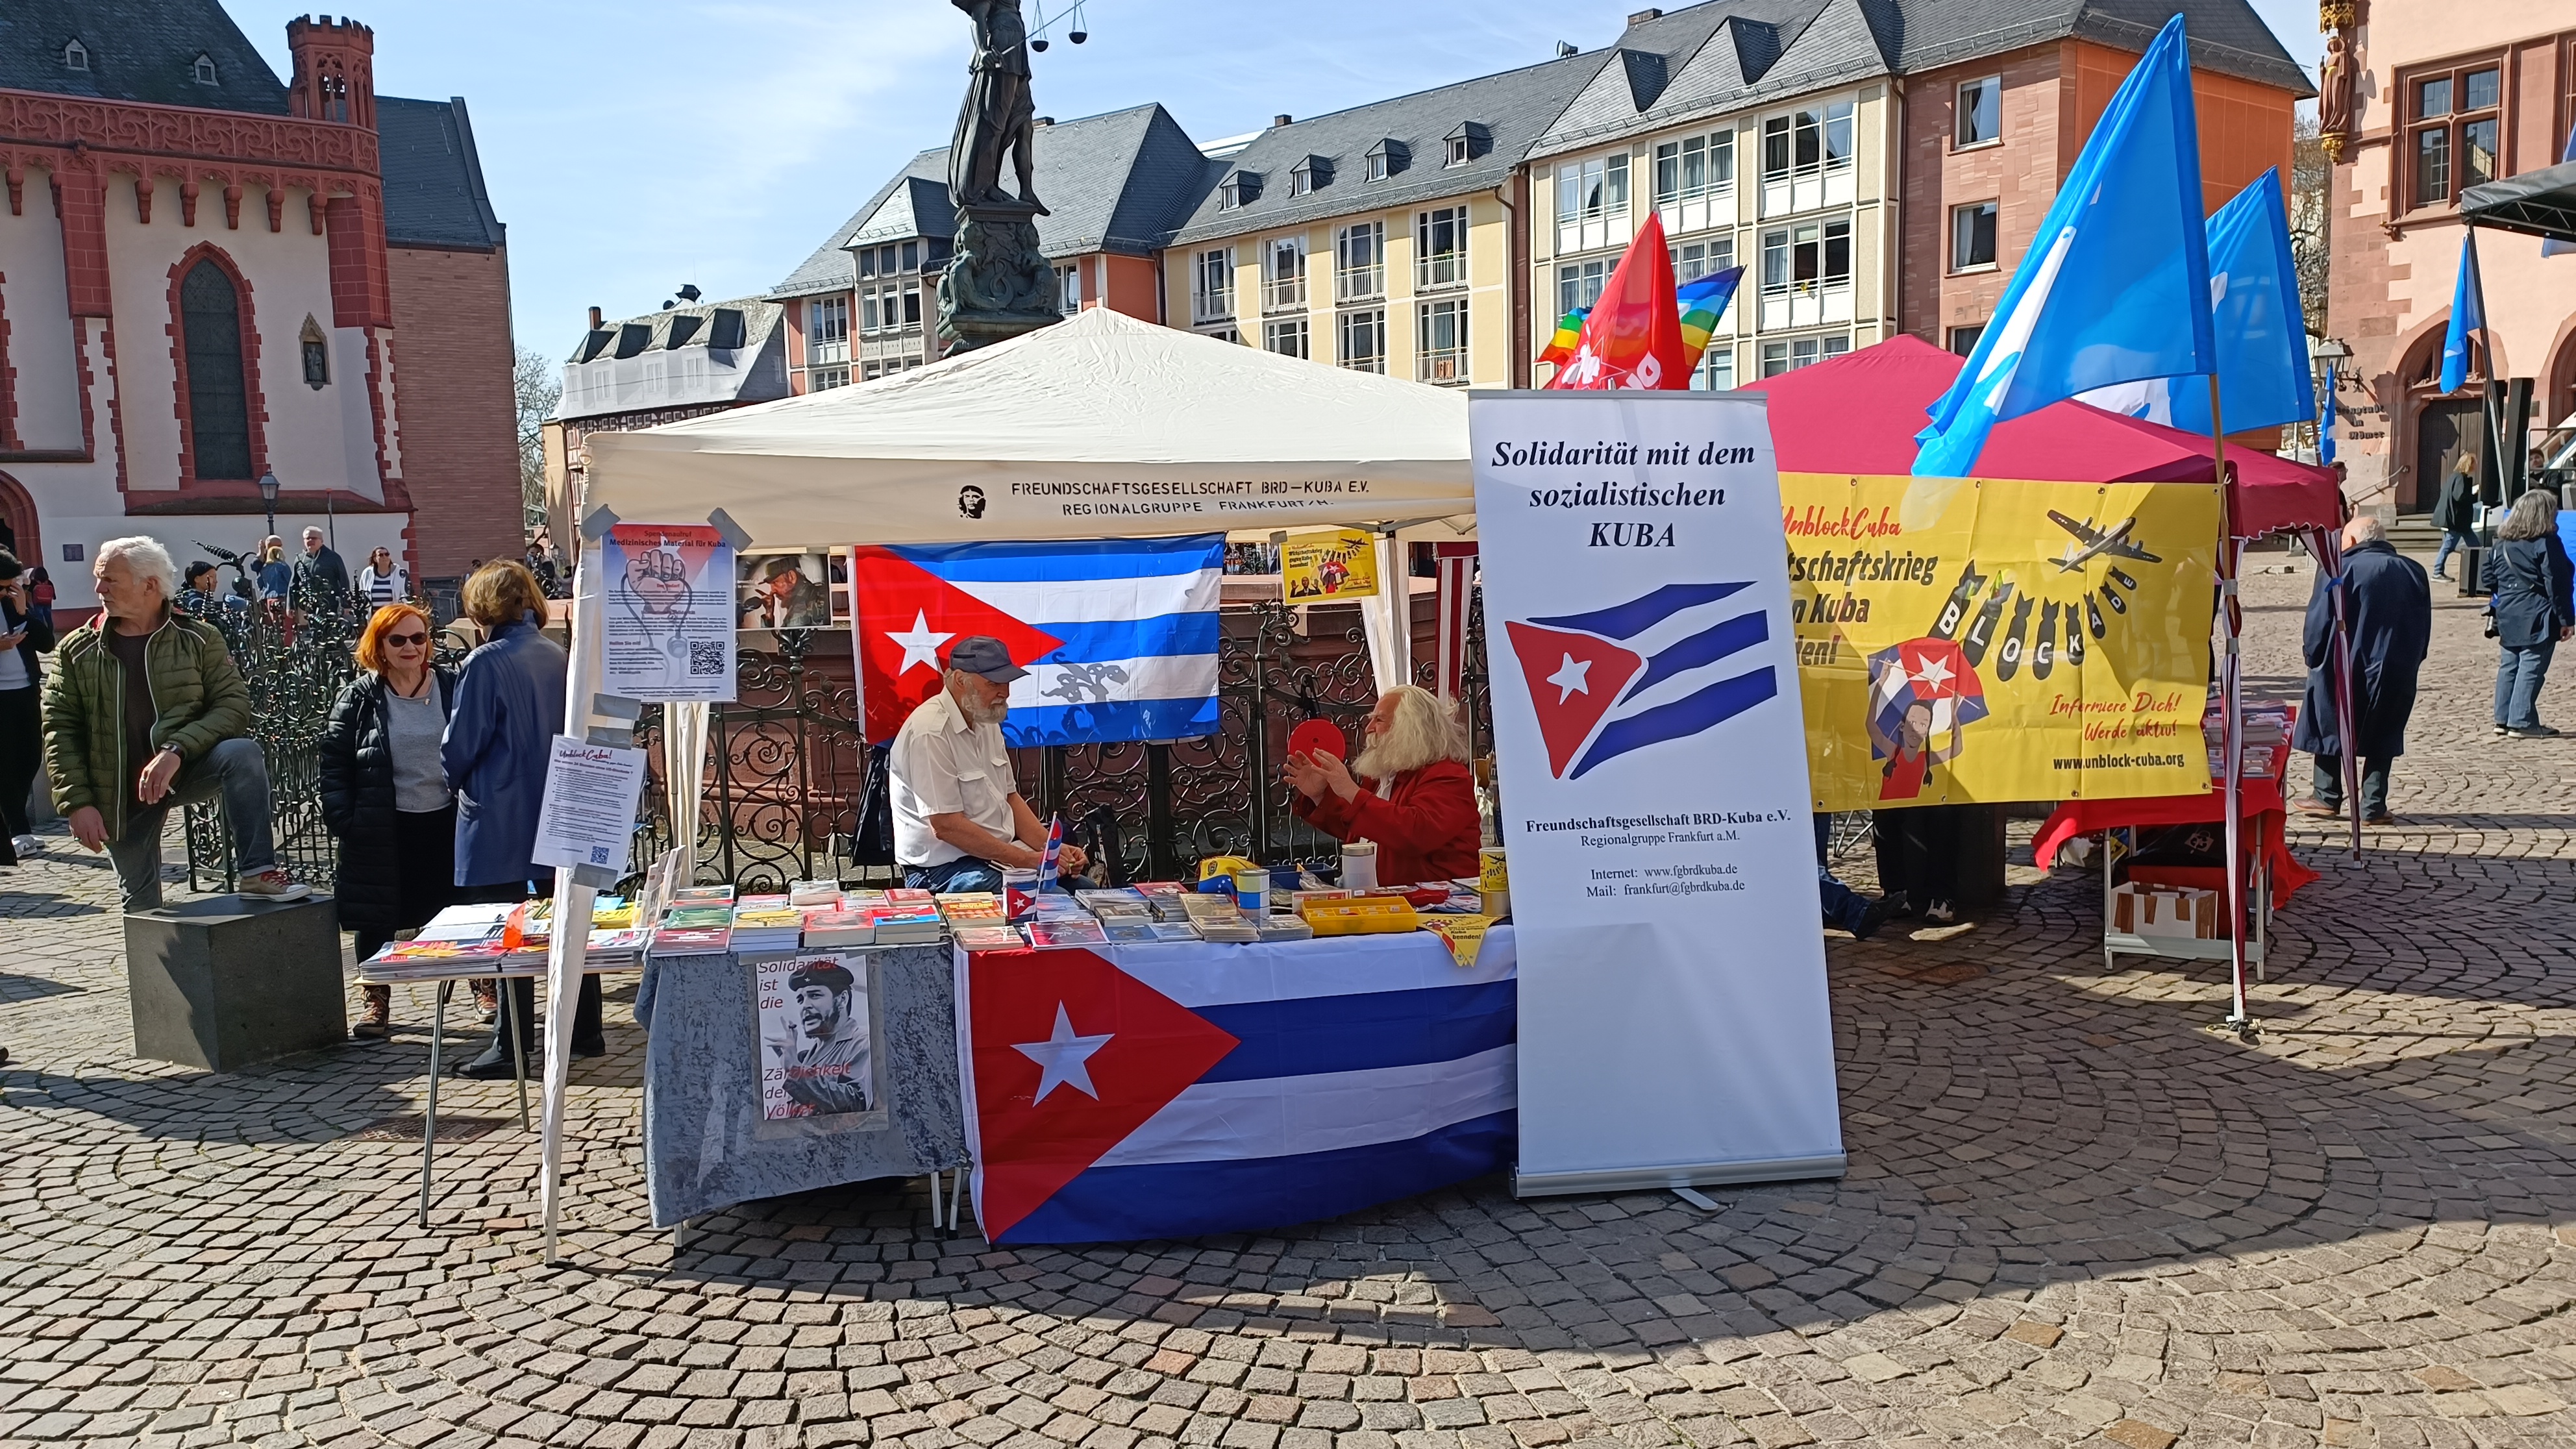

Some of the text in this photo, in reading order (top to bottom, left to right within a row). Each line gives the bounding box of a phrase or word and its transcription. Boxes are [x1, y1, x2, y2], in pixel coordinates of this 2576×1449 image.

[2349, 431, 2385, 440] Römer
[1492, 441, 1755, 467] Solidarität mit dem
[1011, 481, 1252, 495] FREUNDSCHAFTSGESELLSCHAFT
[1348, 480, 1369, 493] E.V.
[1530, 482, 1726, 508] sozialistischen
[1063, 502, 1202, 515] REGIONALGRUPPE
[1588, 522, 1676, 547] KUBA
[1809, 591, 1870, 623] Kuba
[2049, 691, 2182, 719] Informiere Dich!
[2085, 718, 2178, 741] Werde aktiv!
[2053, 752, 2185, 769] www.unblock-cuba.org
[1526, 810, 1791, 834] Freundschaftsgesellschaft BRD-Kuba e.V.
[1581, 830, 1740, 848] Regionalgruppe Frankfurt a.M.
[1591, 863, 1738, 880] Internet: www.fgbrdkuba.de
[1586, 880, 1746, 898] Mail: frankfurt@fgbrdkuba.de
[758, 956, 839, 974] Solidarität
[759, 979, 778, 991] ist
[760, 996, 784, 1009] die
